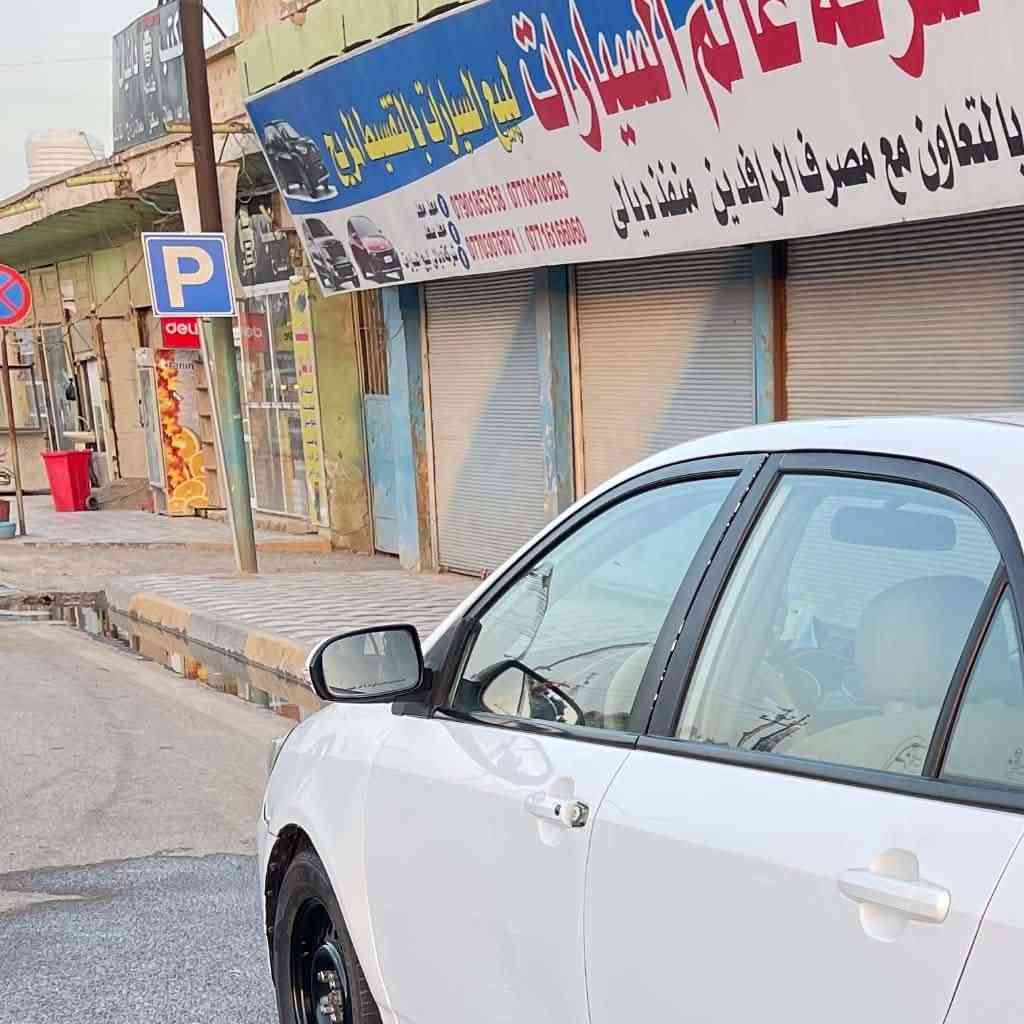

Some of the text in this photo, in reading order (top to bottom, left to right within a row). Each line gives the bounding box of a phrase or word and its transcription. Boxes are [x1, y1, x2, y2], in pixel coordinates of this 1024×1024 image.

[511, 0, 689, 154] السيارات
[646, 158, 699, 218] منفذ
[705, 142, 798, 227] الرافدين
[797, 128, 875, 207] مصرف
[879, 134, 911, 205] مع
[162, 246, 214, 308] P
